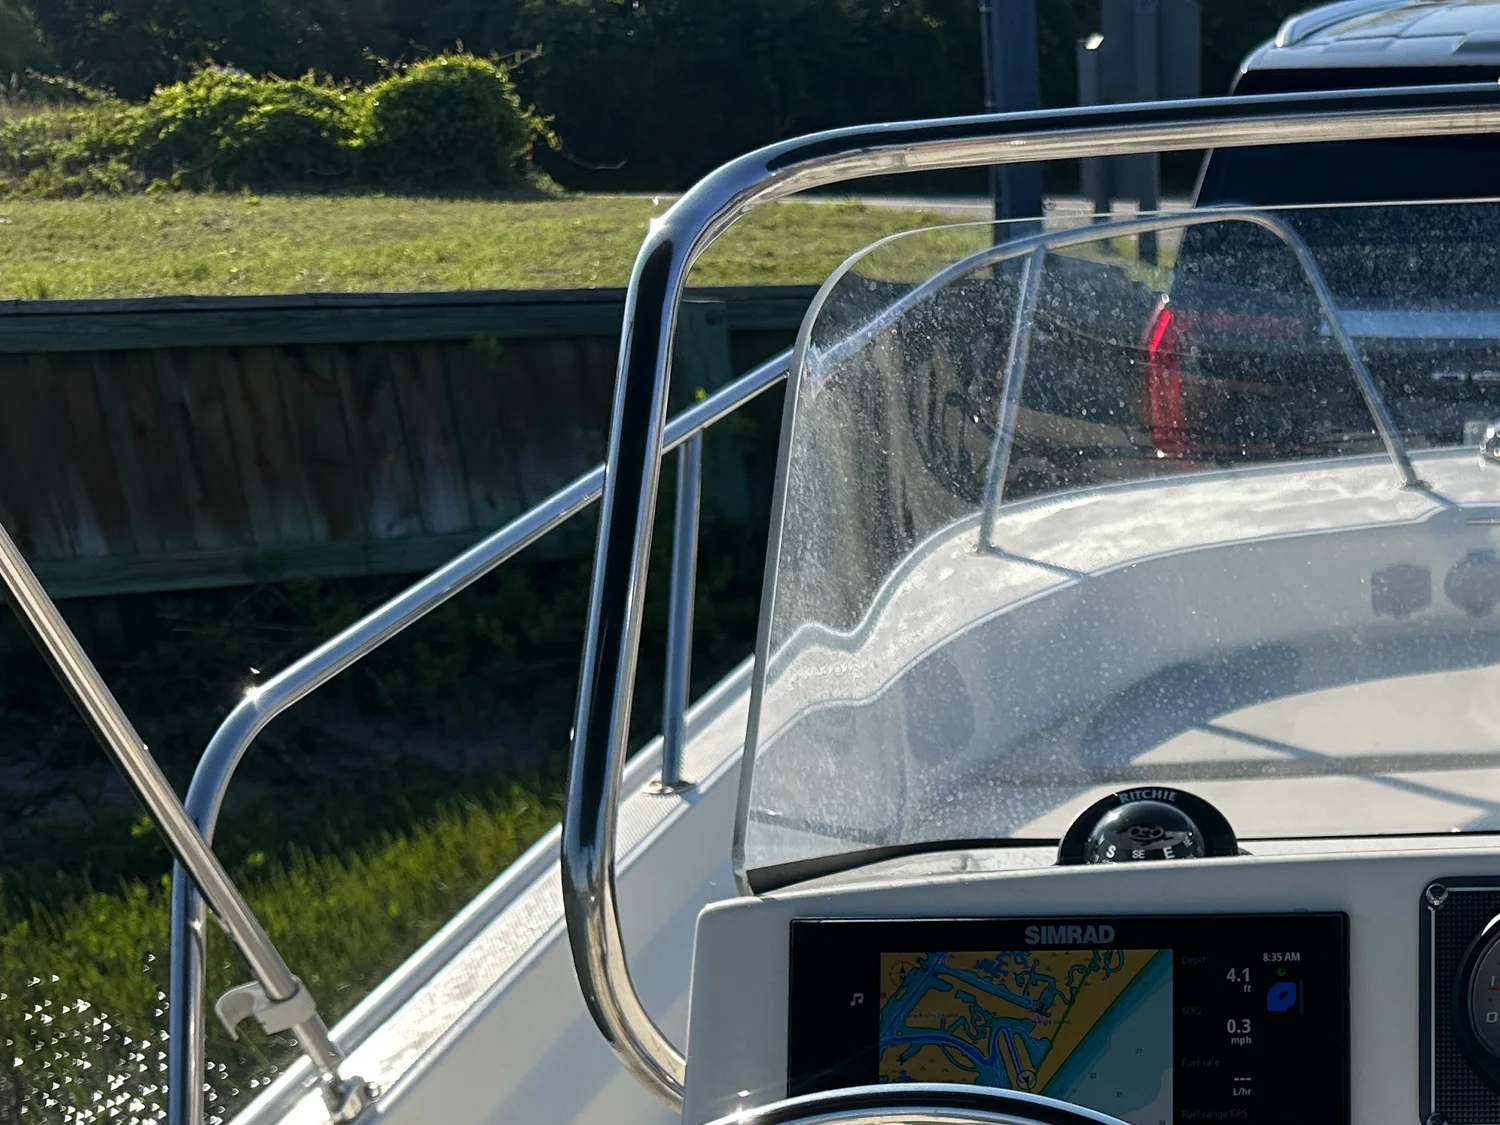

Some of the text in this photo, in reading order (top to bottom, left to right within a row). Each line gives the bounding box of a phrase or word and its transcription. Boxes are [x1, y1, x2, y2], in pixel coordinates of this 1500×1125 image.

[1119, 789, 1178, 804] RITCHIE
[1106, 845, 1175, 859] S SE E
[1024, 925, 1115, 946] SIMRAD
[1181, 956, 1209, 966] Depth
[1262, 952, 1301, 962] 8:35 AM
[1226, 967, 1250, 982] 4.1
[1243, 985, 1252, 993] ft
[1181, 1006, 1202, 1016] SOG
[1486, 1012, 1498, 1023] 0
[1226, 1019, 1251, 1034] 0.3
[1231, 1036, 1252, 1046] mph
[1181, 1058, 1220, 1067] Fuel rate
[1233, 1087, 1252, 1096] L/hr
[1181, 1108, 1248, 1121] Fuel range GPS
